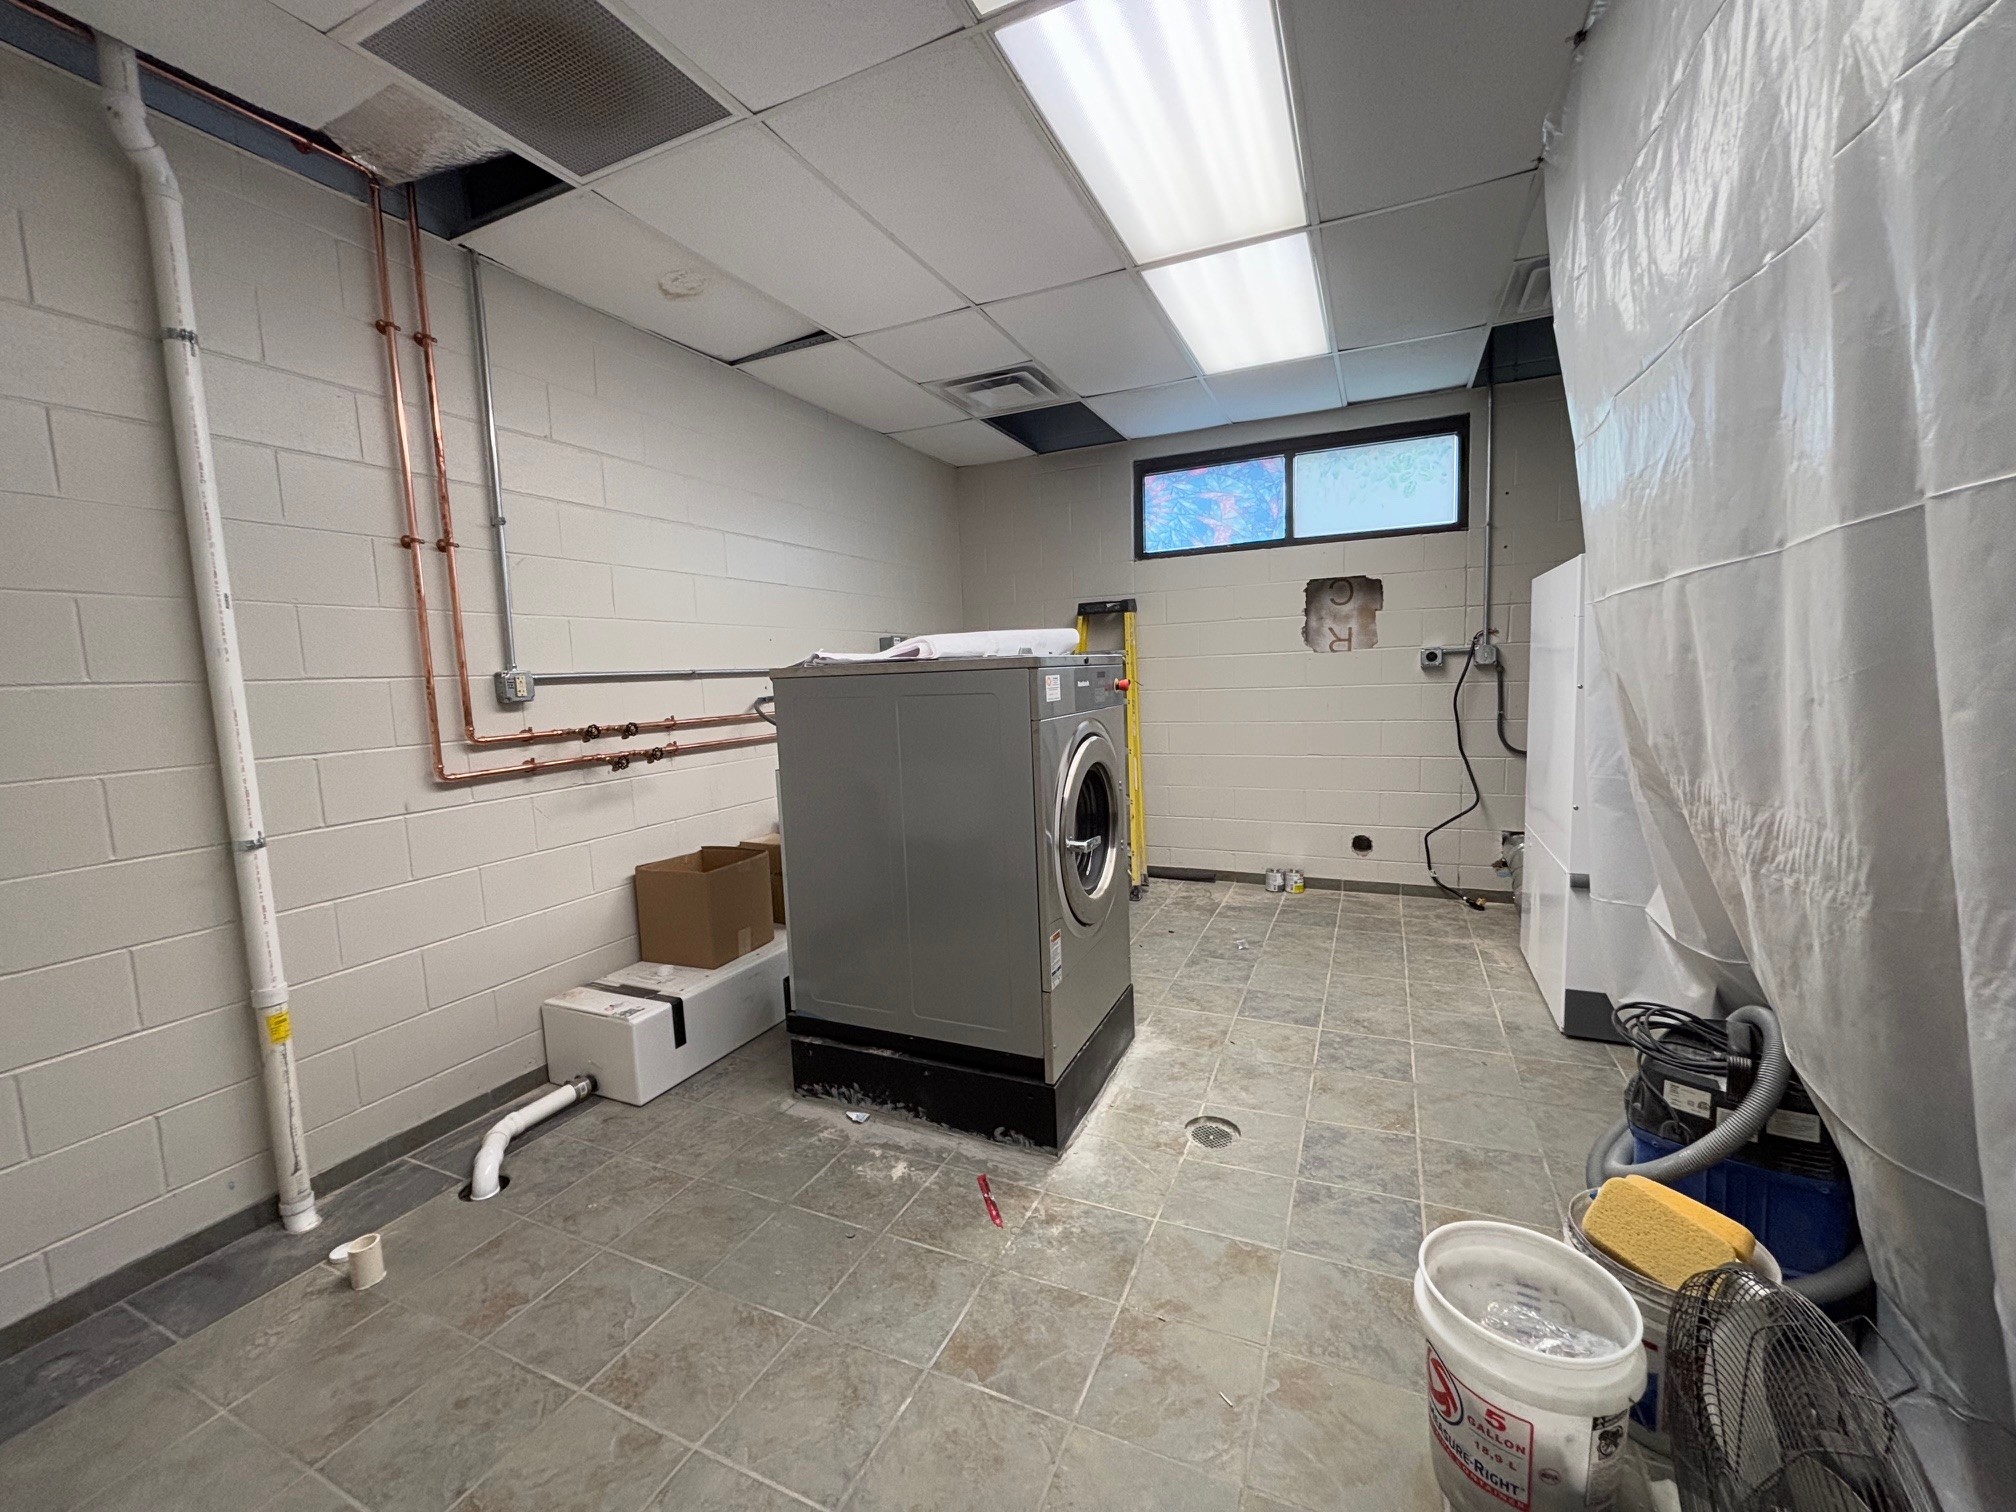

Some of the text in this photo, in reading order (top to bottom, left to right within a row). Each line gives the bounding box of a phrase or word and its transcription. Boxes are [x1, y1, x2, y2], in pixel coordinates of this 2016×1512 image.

[1484, 1408, 1506, 1431] 5
[1467, 1415, 1526, 1455] GALLON
[1508, 1461, 1517, 1471] L
